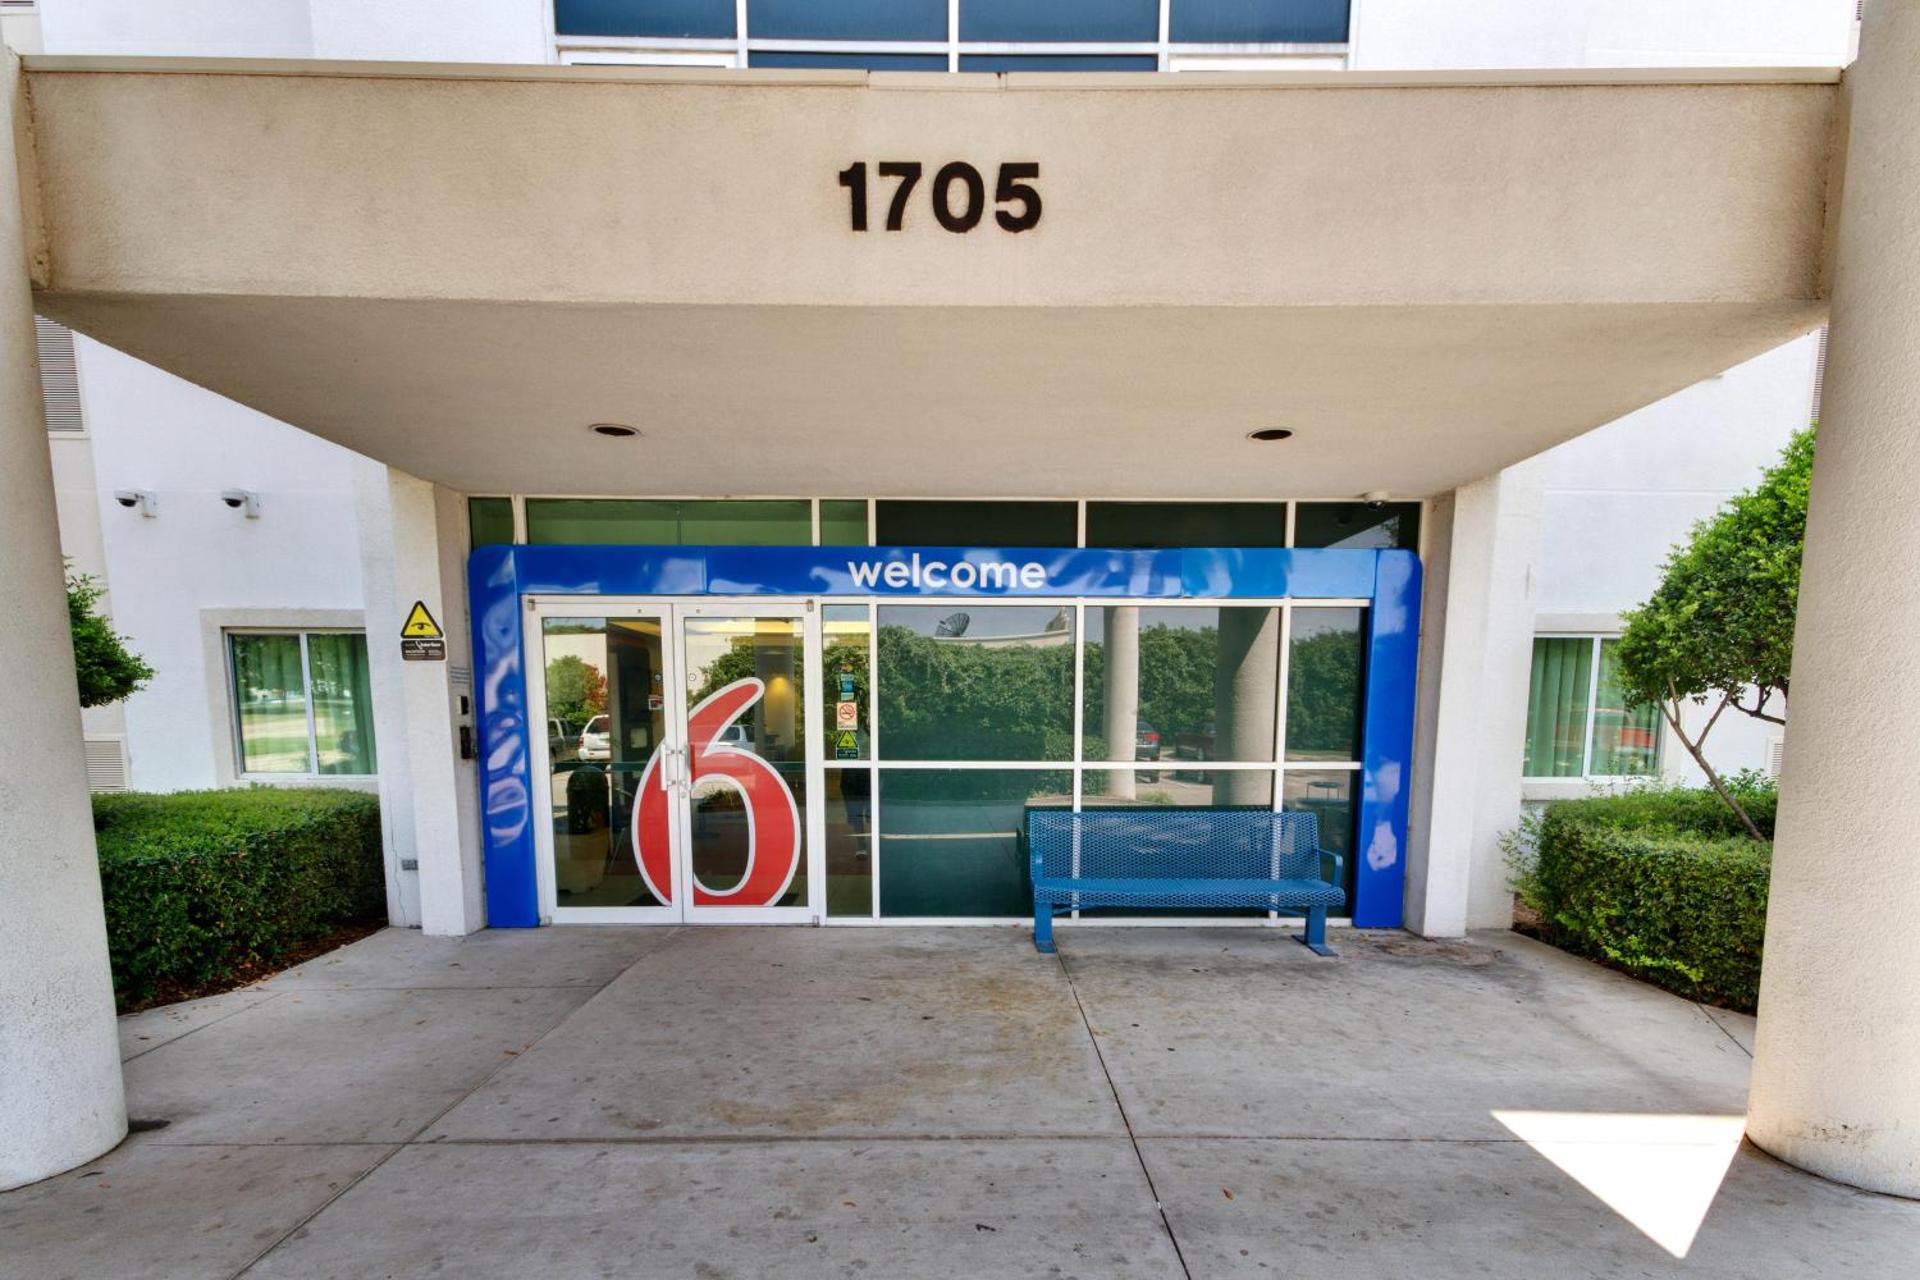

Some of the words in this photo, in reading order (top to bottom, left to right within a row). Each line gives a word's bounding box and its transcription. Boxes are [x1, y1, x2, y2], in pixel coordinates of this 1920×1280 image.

[839, 161, 1042, 233] 1705
[848, 553, 1047, 588] welcome
[631, 677, 801, 906] 6
